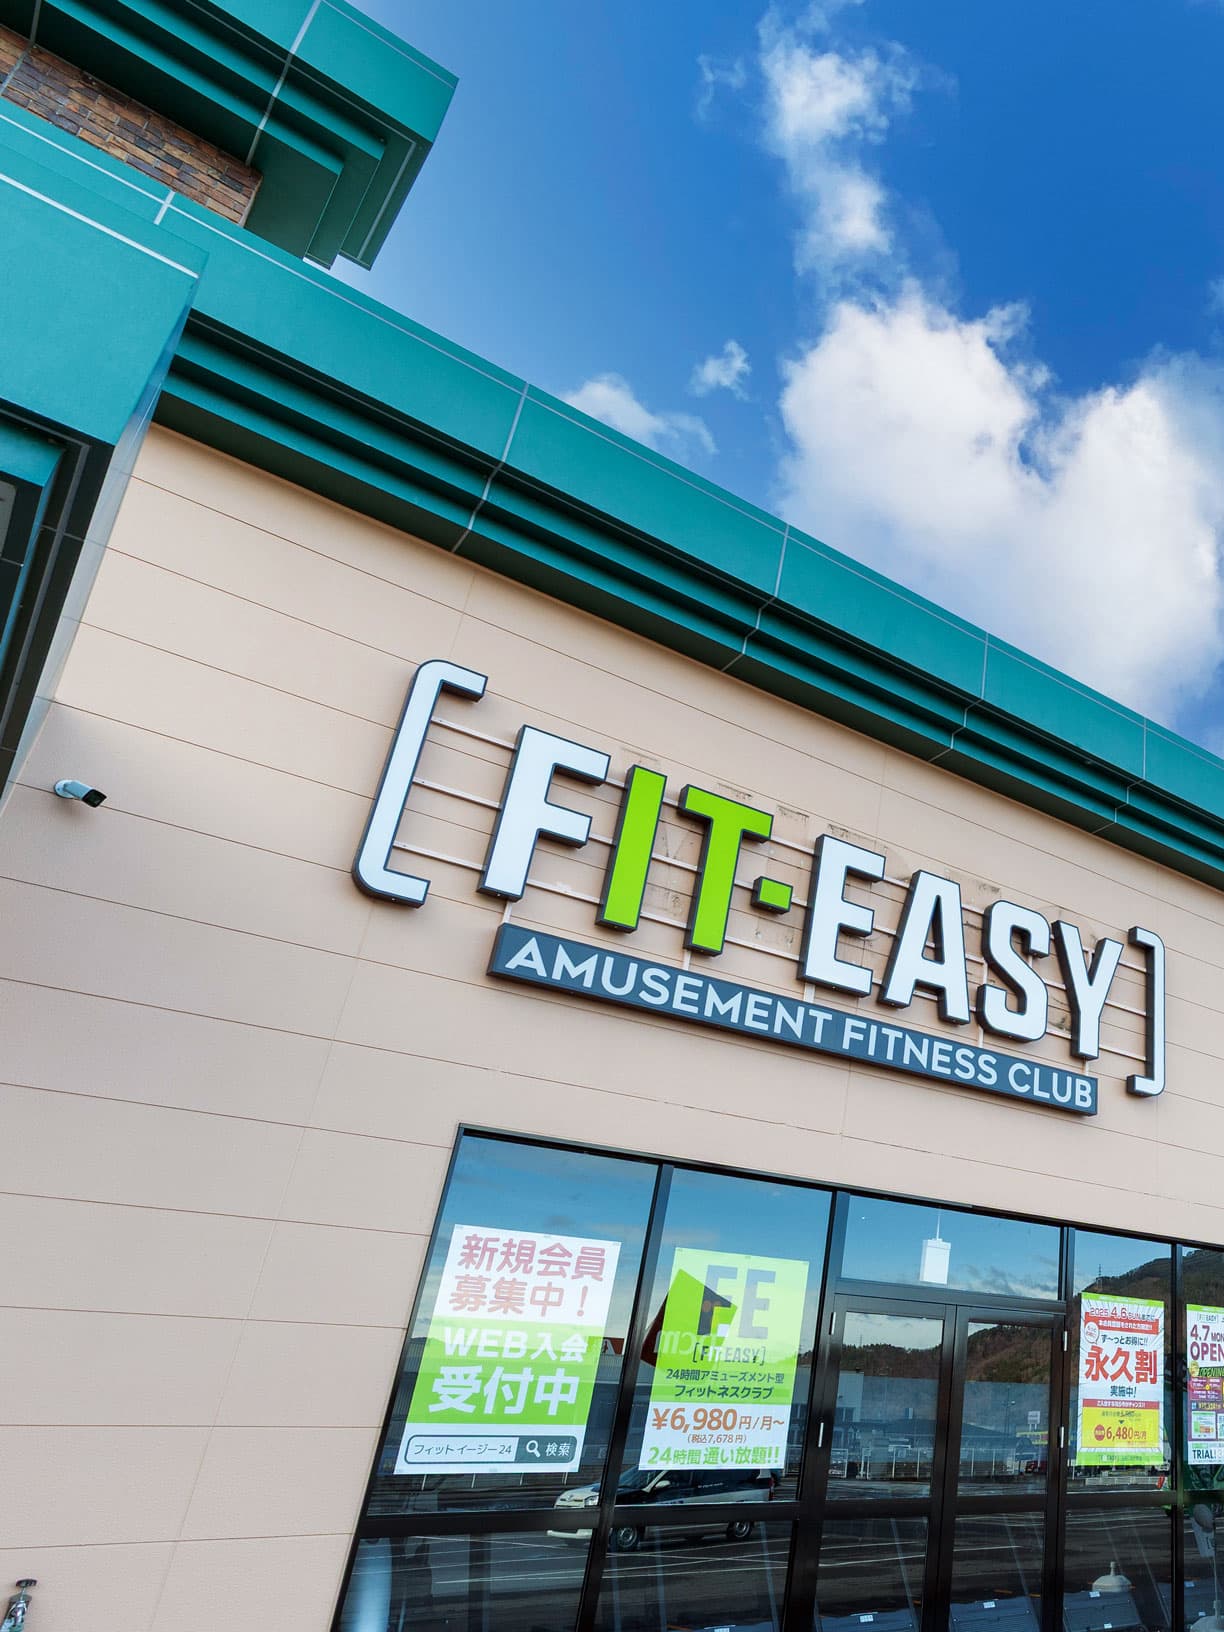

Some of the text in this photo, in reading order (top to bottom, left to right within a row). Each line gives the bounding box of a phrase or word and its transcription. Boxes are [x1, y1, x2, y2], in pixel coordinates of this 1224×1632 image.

[504, 936, 1094, 1109] AMUSEMENT FITNESS CLUB
[457, 1234, 606, 1282] 新規会員
[443, 1327, 588, 1363] WEB入会
[1190, 1324, 1210, 1341] 4.7
[666, 1368, 785, 1384] 24時間アミューズメント型
[1085, 1345, 1158, 1384] 永久割
[428, 1365, 580, 1416] 受付中
[674, 1385, 774, 1400] フィットネスクラブ
[545, 1443, 571, 1457] 検索
